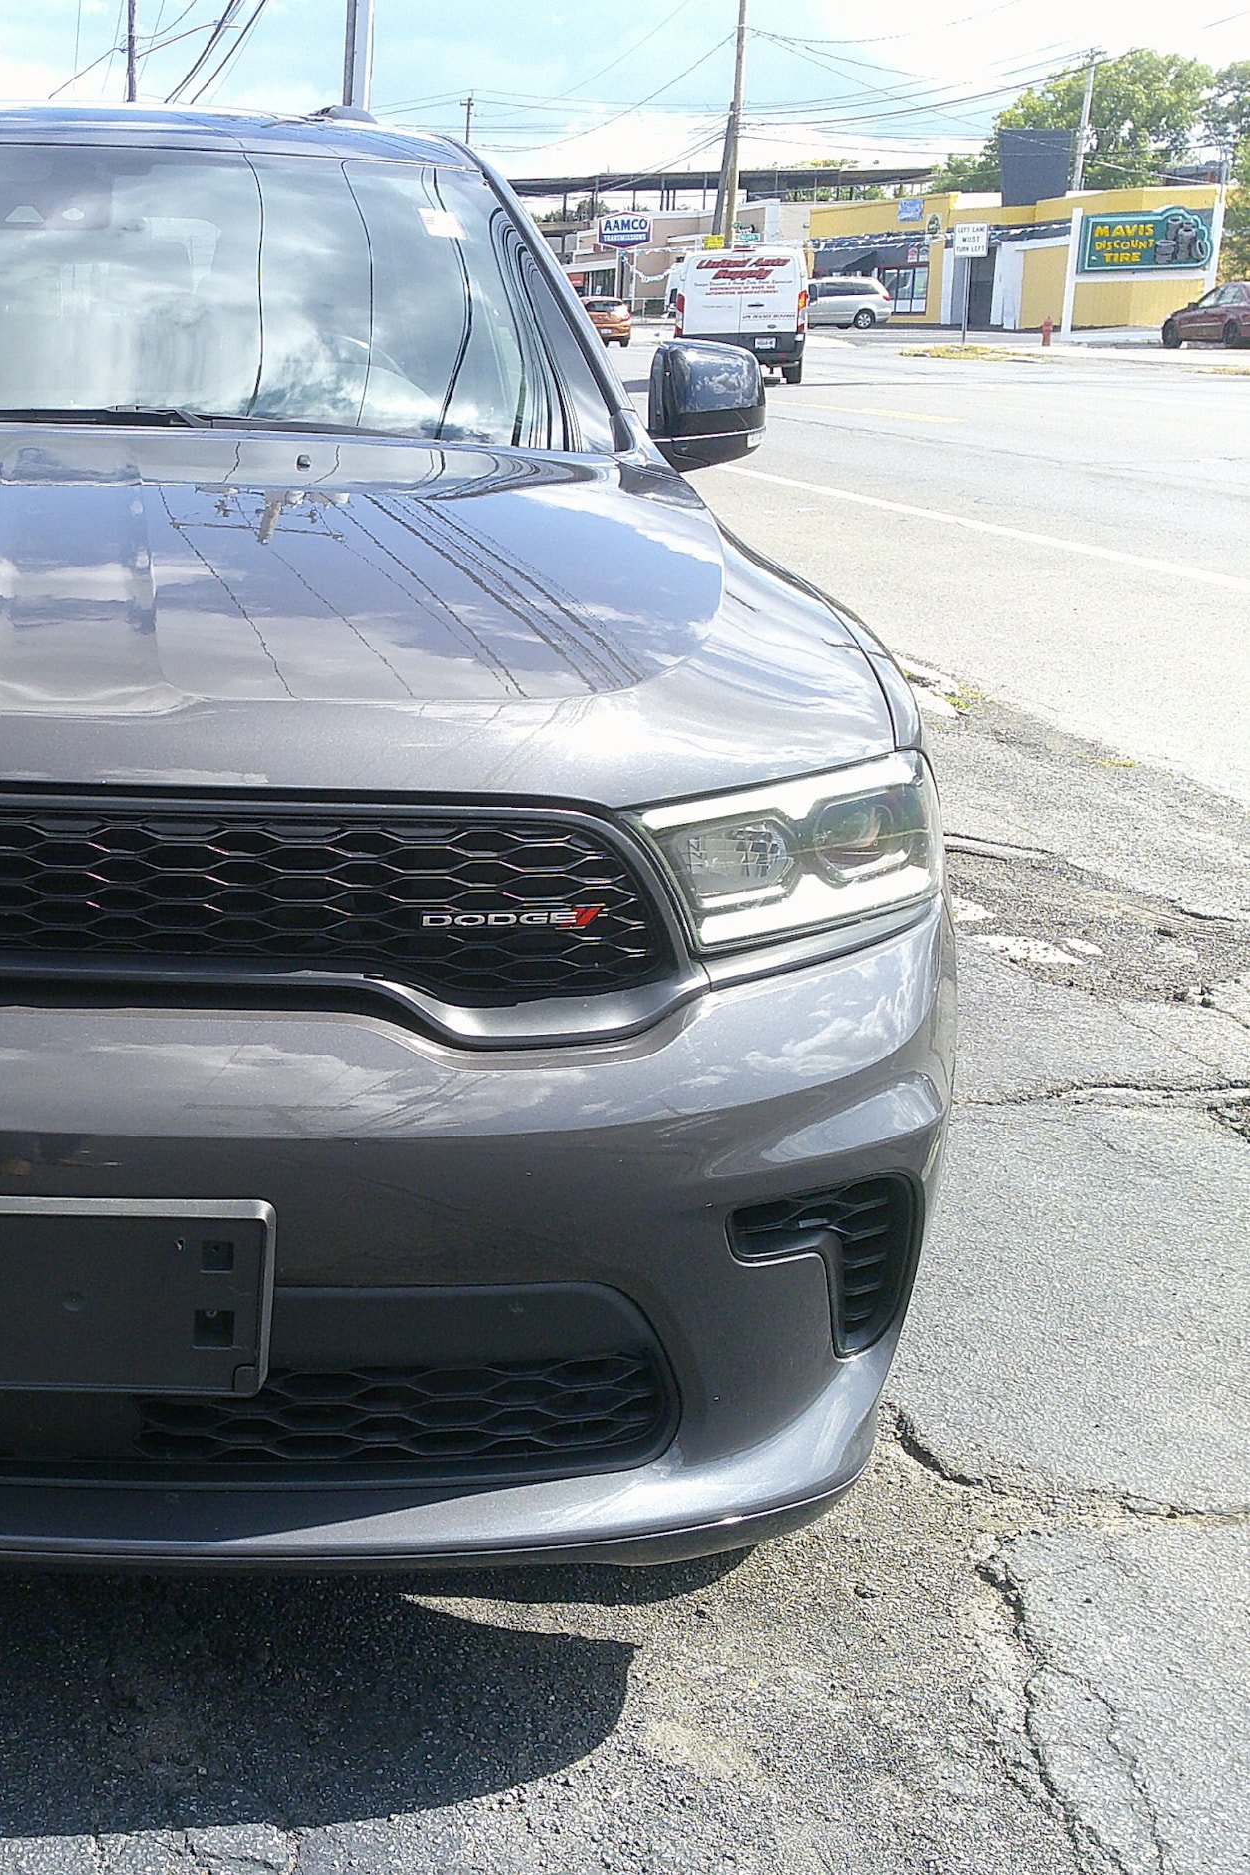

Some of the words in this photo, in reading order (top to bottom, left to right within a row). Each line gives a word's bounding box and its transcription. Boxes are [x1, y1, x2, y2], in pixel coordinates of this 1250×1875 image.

[603, 218, 648, 231] AAMCO
[1094, 224, 1154, 237] MAVIS
[749, 257, 791, 267] Auto
[1103, 252, 1141, 263] TIRE
[712, 268, 775, 280] Supply
[421, 911, 578, 927] DODGE
